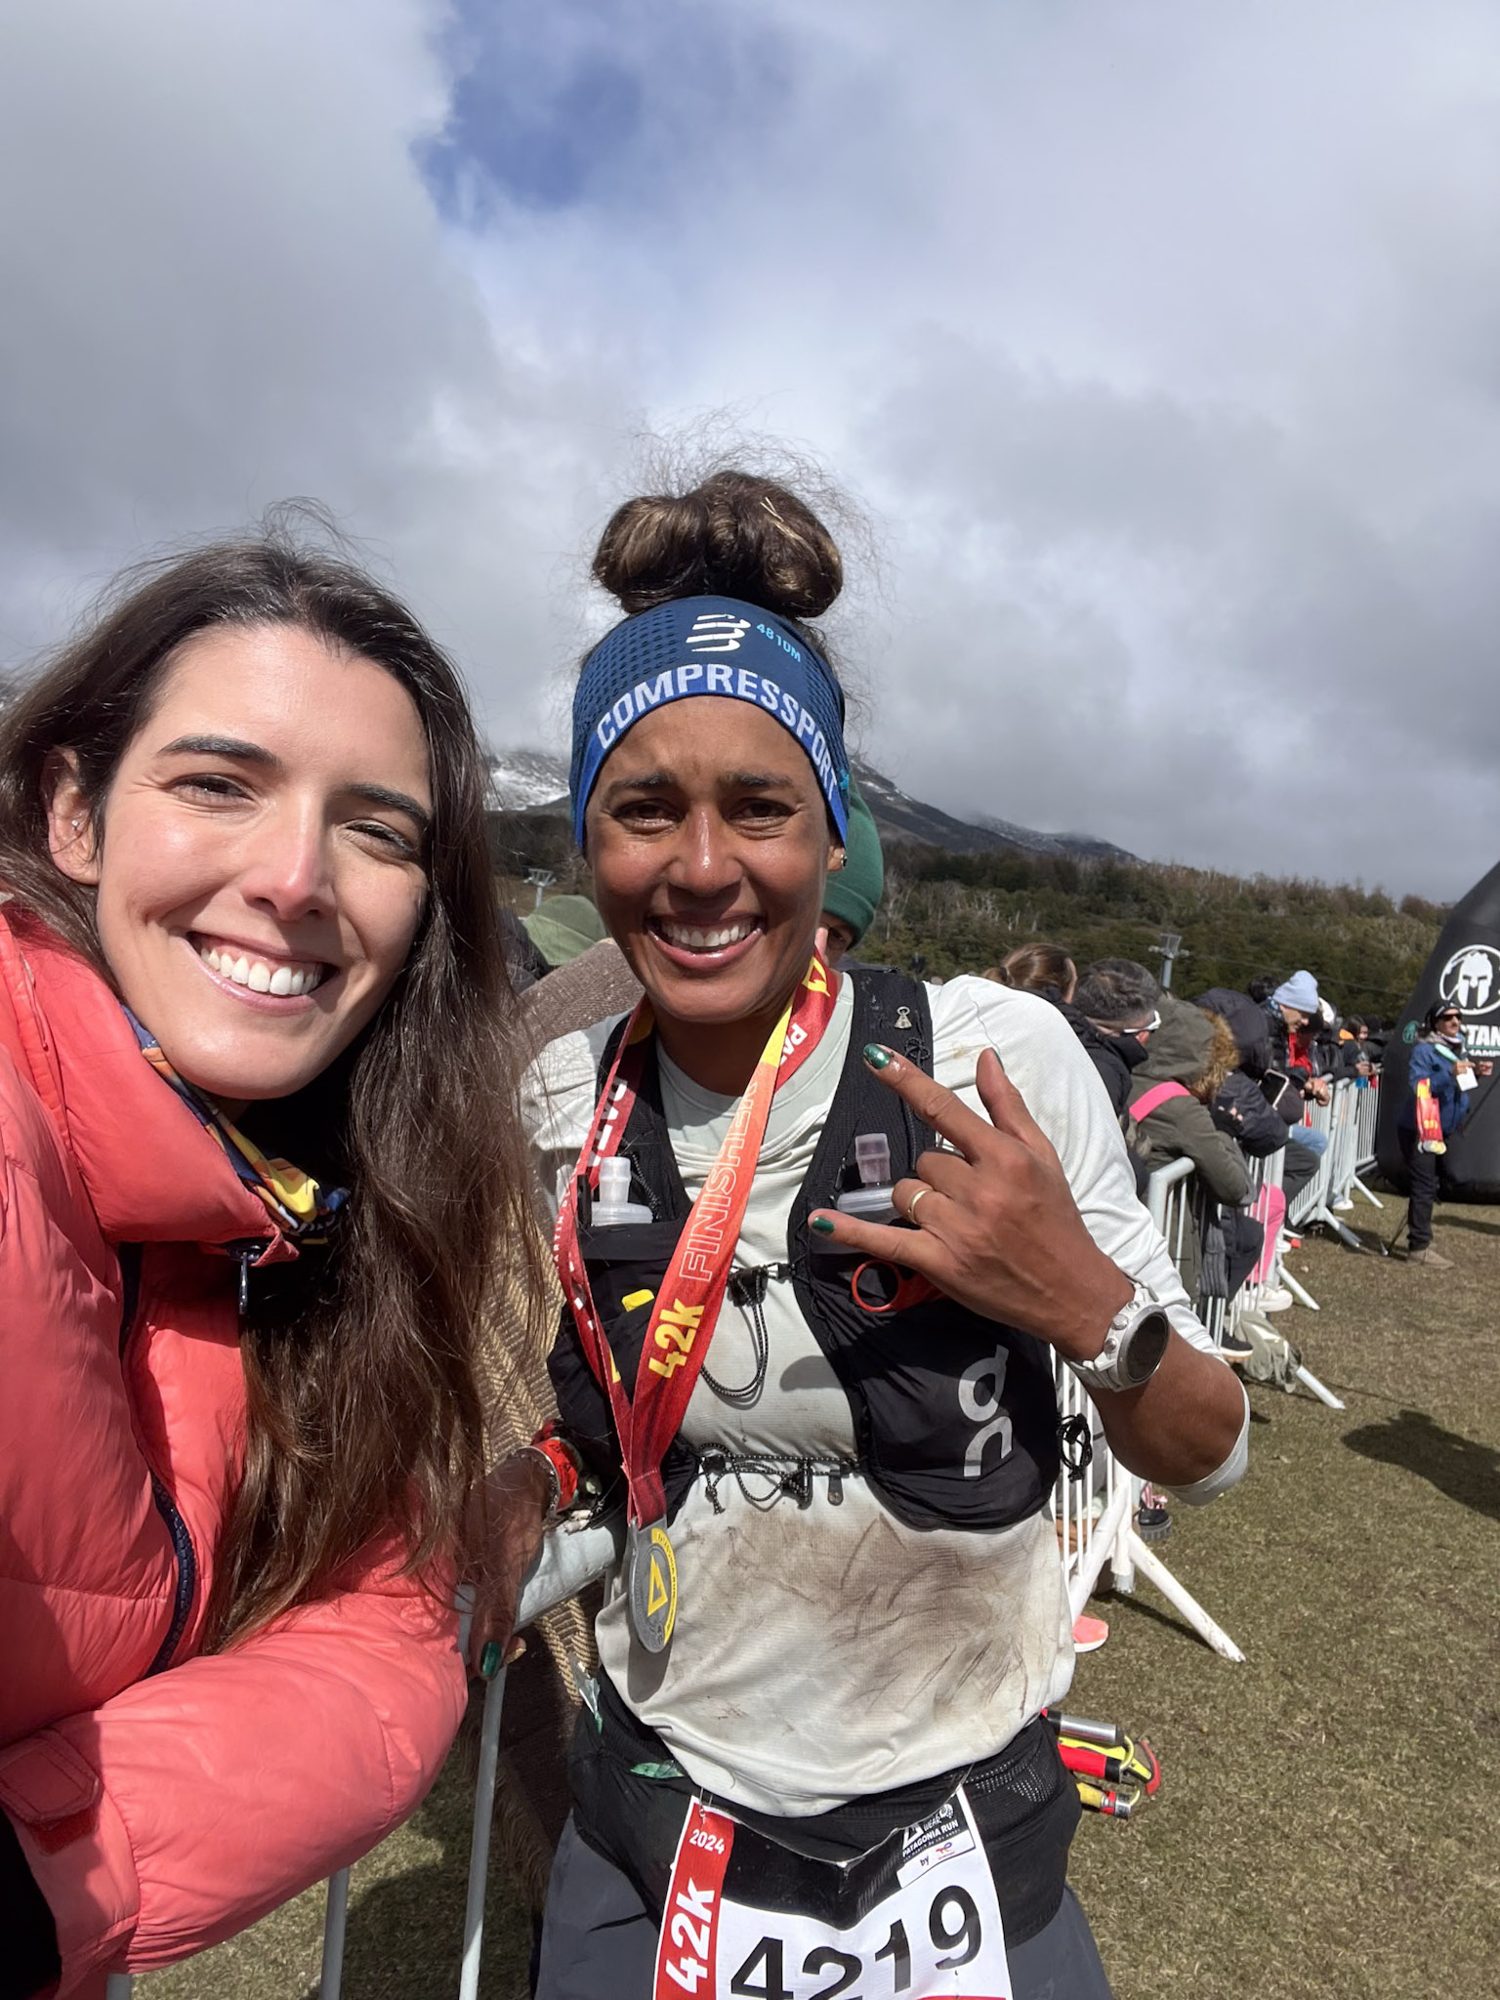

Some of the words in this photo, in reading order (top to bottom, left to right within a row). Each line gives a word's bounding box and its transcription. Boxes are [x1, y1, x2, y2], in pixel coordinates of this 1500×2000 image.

[756, 622, 801, 663] 4810M
[596, 663, 837, 801] COMPRESSPORT
[689, 1829, 725, 1855] 2024
[902, 1828, 941, 1857] PATAGONIA
[940, 1819, 959, 1834] RUN
[920, 1856, 930, 1867] by
[730, 1885, 982, 2000] 4219
